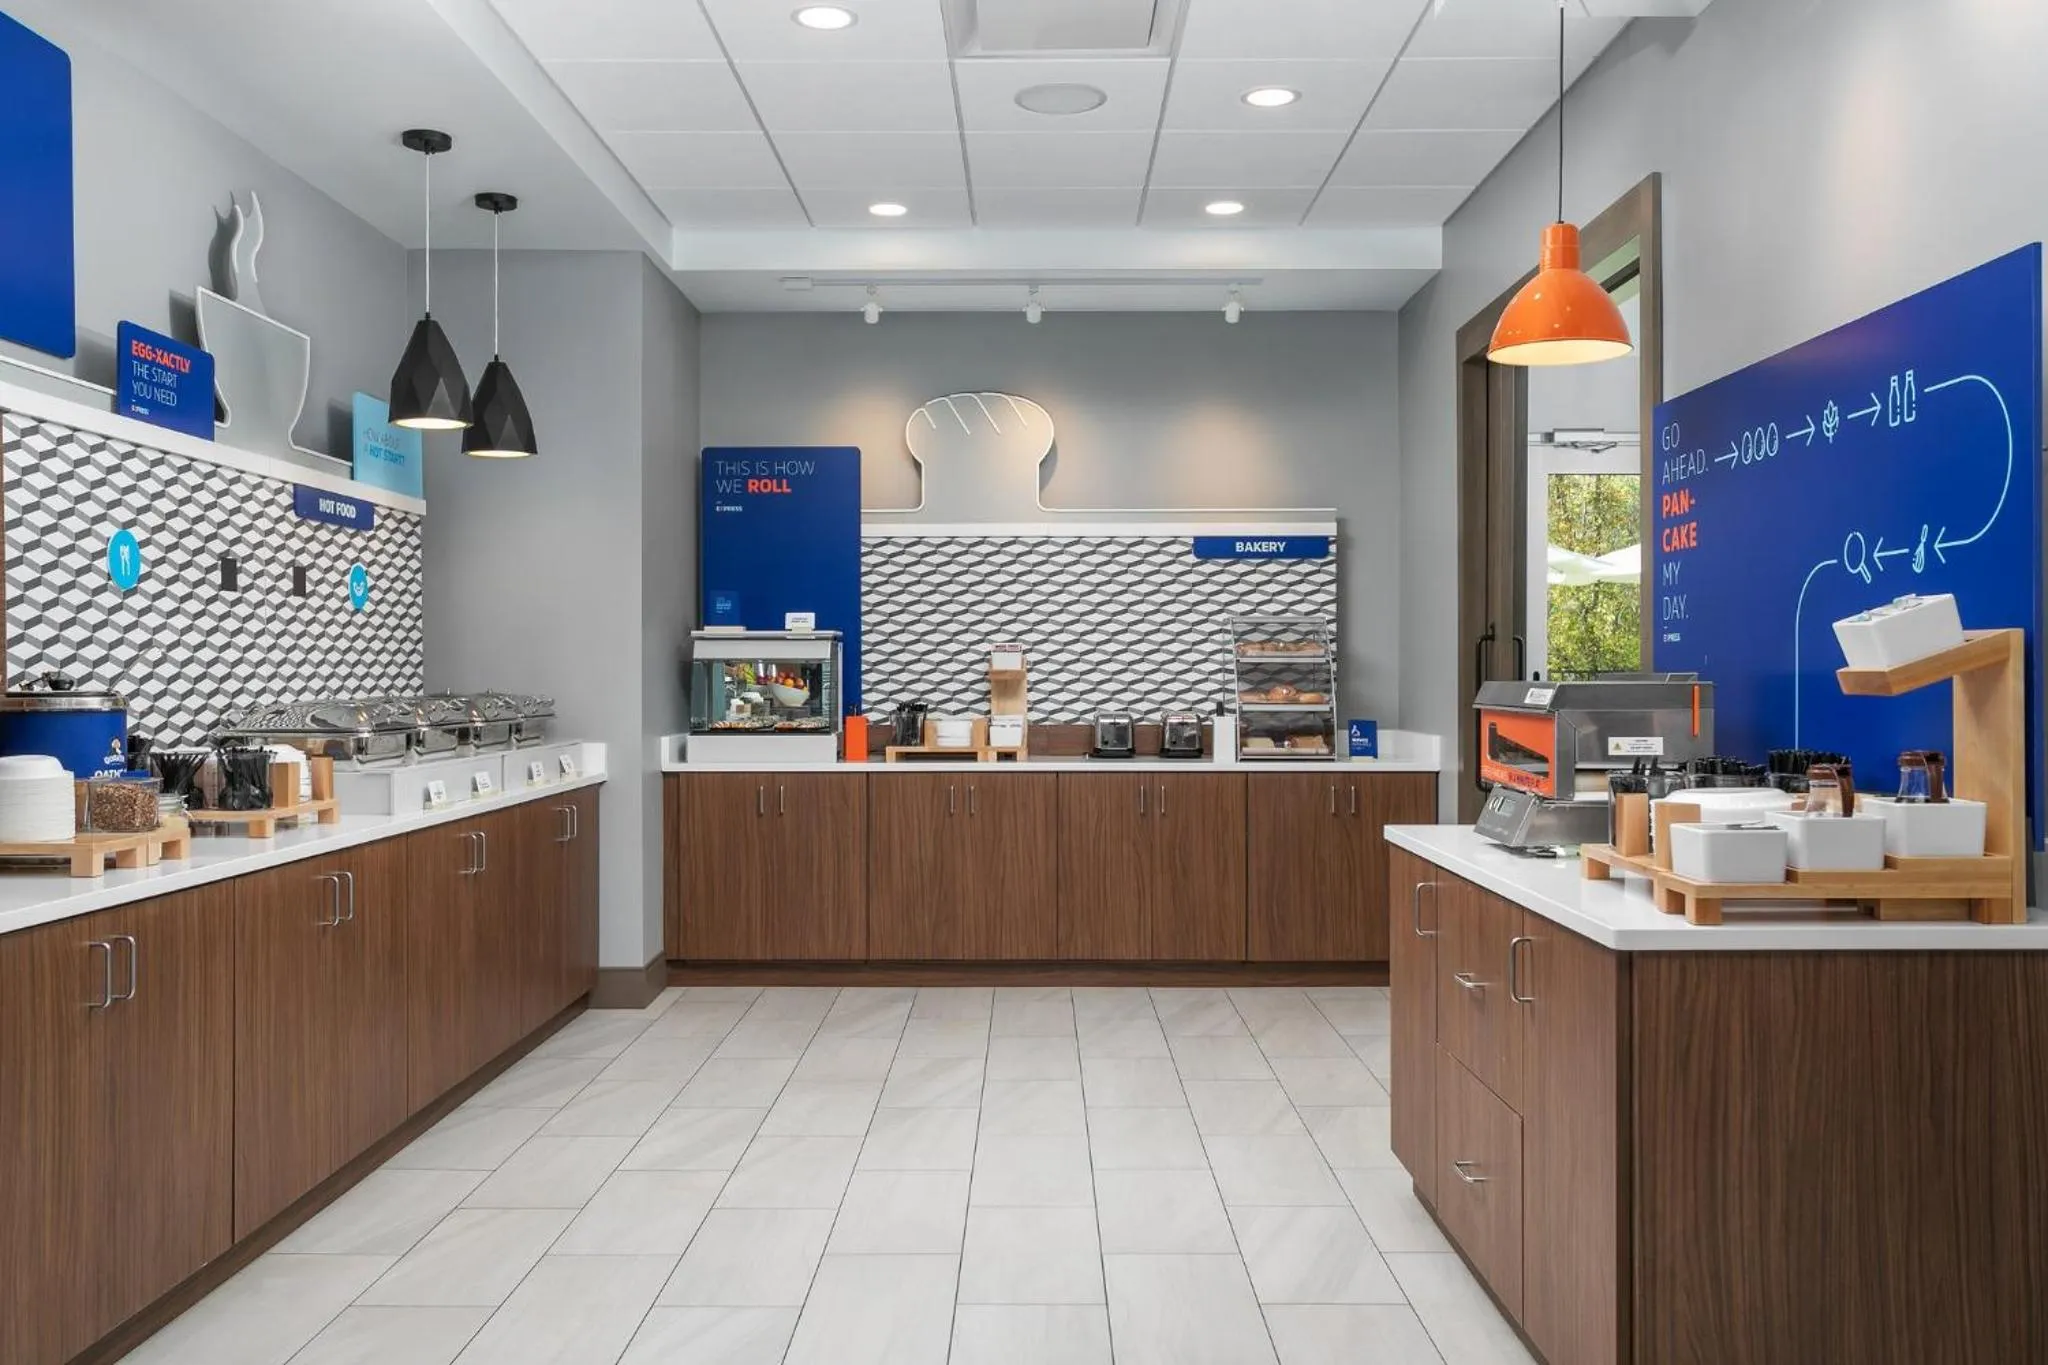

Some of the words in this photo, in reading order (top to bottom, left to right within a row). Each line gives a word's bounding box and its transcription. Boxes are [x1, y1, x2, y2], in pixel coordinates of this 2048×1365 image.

[131, 339, 191, 373] EGG-XACTLY
[131, 360, 150, 380] THE
[152, 367, 178, 389] START
[131, 380, 152, 400] YOU
[153, 386, 177, 406] NEED
[1662, 422, 1680, 451] GO
[716, 460, 751, 475] THIS
[756, 461, 769, 475] IS
[774, 460, 816, 475] HOW
[1662, 448, 1709, 486] AHEAD.
[716, 479, 742, 494] WE
[747, 478, 792, 493] ROLL
[319, 498, 335, 514] HOT
[336, 502, 356, 519] FOOD
[1662, 488, 1696, 520] PAN-
[1235, 541, 1286, 553] BAKERY
[1662, 522, 1697, 553] CAKE
[1662, 560, 1681, 587] MY
[1662, 593, 1689, 621] DAY.
